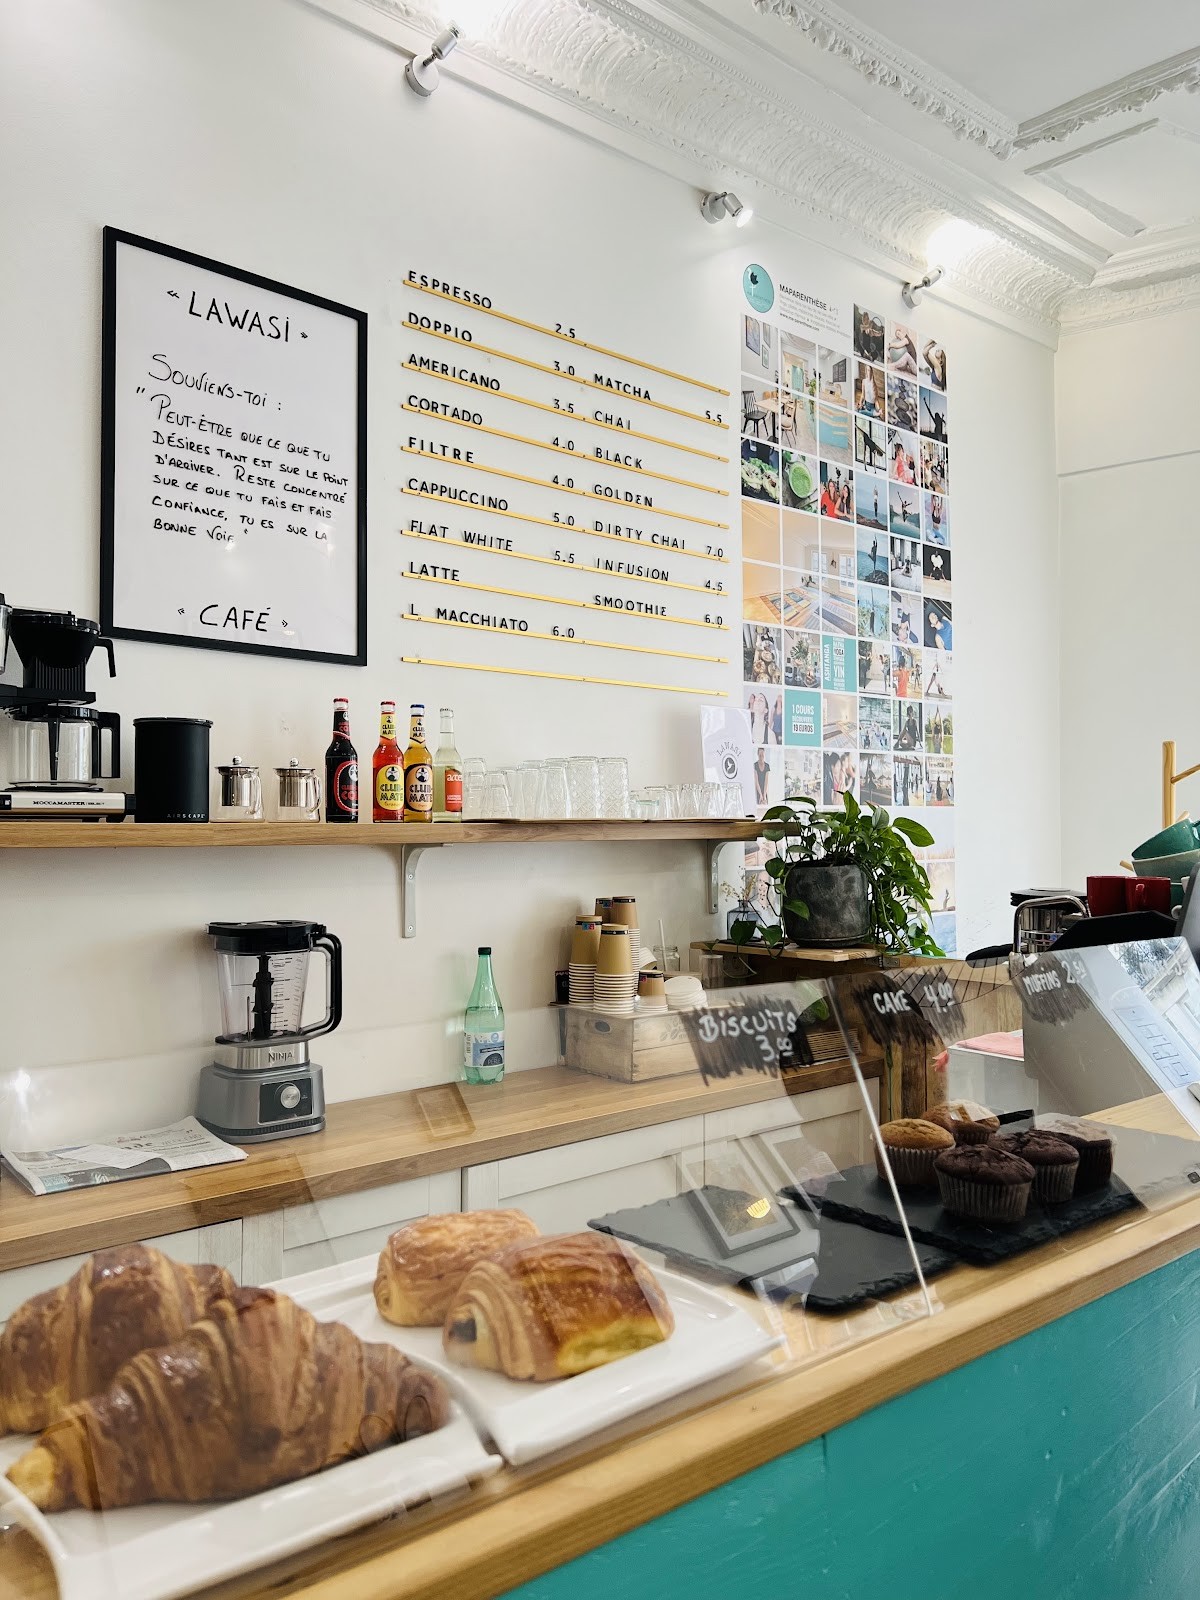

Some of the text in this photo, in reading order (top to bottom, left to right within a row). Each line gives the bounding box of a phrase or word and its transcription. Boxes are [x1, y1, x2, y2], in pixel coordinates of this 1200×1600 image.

[408, 271, 576, 339] ESPRESSO 2.5
[408, 312, 576, 376] DOPPIO 3.0
[408, 353, 575, 414] AMERICANO 3.5
[593, 373, 723, 424] MATCHA 5.5
[408, 394, 575, 451] CORTADO 4.0
[593, 410, 631, 430] CHAI
[216, 448, 248, 463] TANT
[253, 457, 273, 469] EST
[279, 463, 300, 475] SUR
[306, 469, 319, 479] LE
[240, 432, 263, 445] QUE
[267, 438, 281, 449] CE
[287, 443, 310, 457] QUE
[313, 449, 331, 462] TU
[408, 436, 575, 489] FILTRE 4.0
[595, 447, 643, 469] BLACK
[153, 474, 180, 488] SUR
[185, 481, 199, 492] CE
[205, 486, 231, 498] QUE
[236, 492, 253, 502] TU
[291, 503, 305, 512] ET
[233, 464, 276, 489] RESTE
[283, 483, 348, 504] CONCENTRÉ
[593, 484, 653, 507] GOLDEN
[408, 478, 575, 527] CAPPUCCINO 5.0
[153, 518, 197, 536] BONNE
[239, 514, 255, 525] TU
[260, 519, 275, 529] ES
[286, 524, 308, 537] SUR
[315, 530, 328, 541] LA
[410, 519, 576, 564] FLAT WHITE 5.5
[594, 520, 724, 559] DIRTY CHAI 7.0
[410, 561, 461, 582] LATTE
[595, 557, 724, 592] INFUSION 4.5
[199, 603, 271, 632] CAFÉ
[410, 603, 575, 639] L MACCHIATO 6.0
[594, 594, 724, 626] SMOOTHIE 6.0
[795, 704, 815, 716] COURS
[873, 989, 911, 1014] CAKE
[268, 1051, 293, 1062] NINJA
